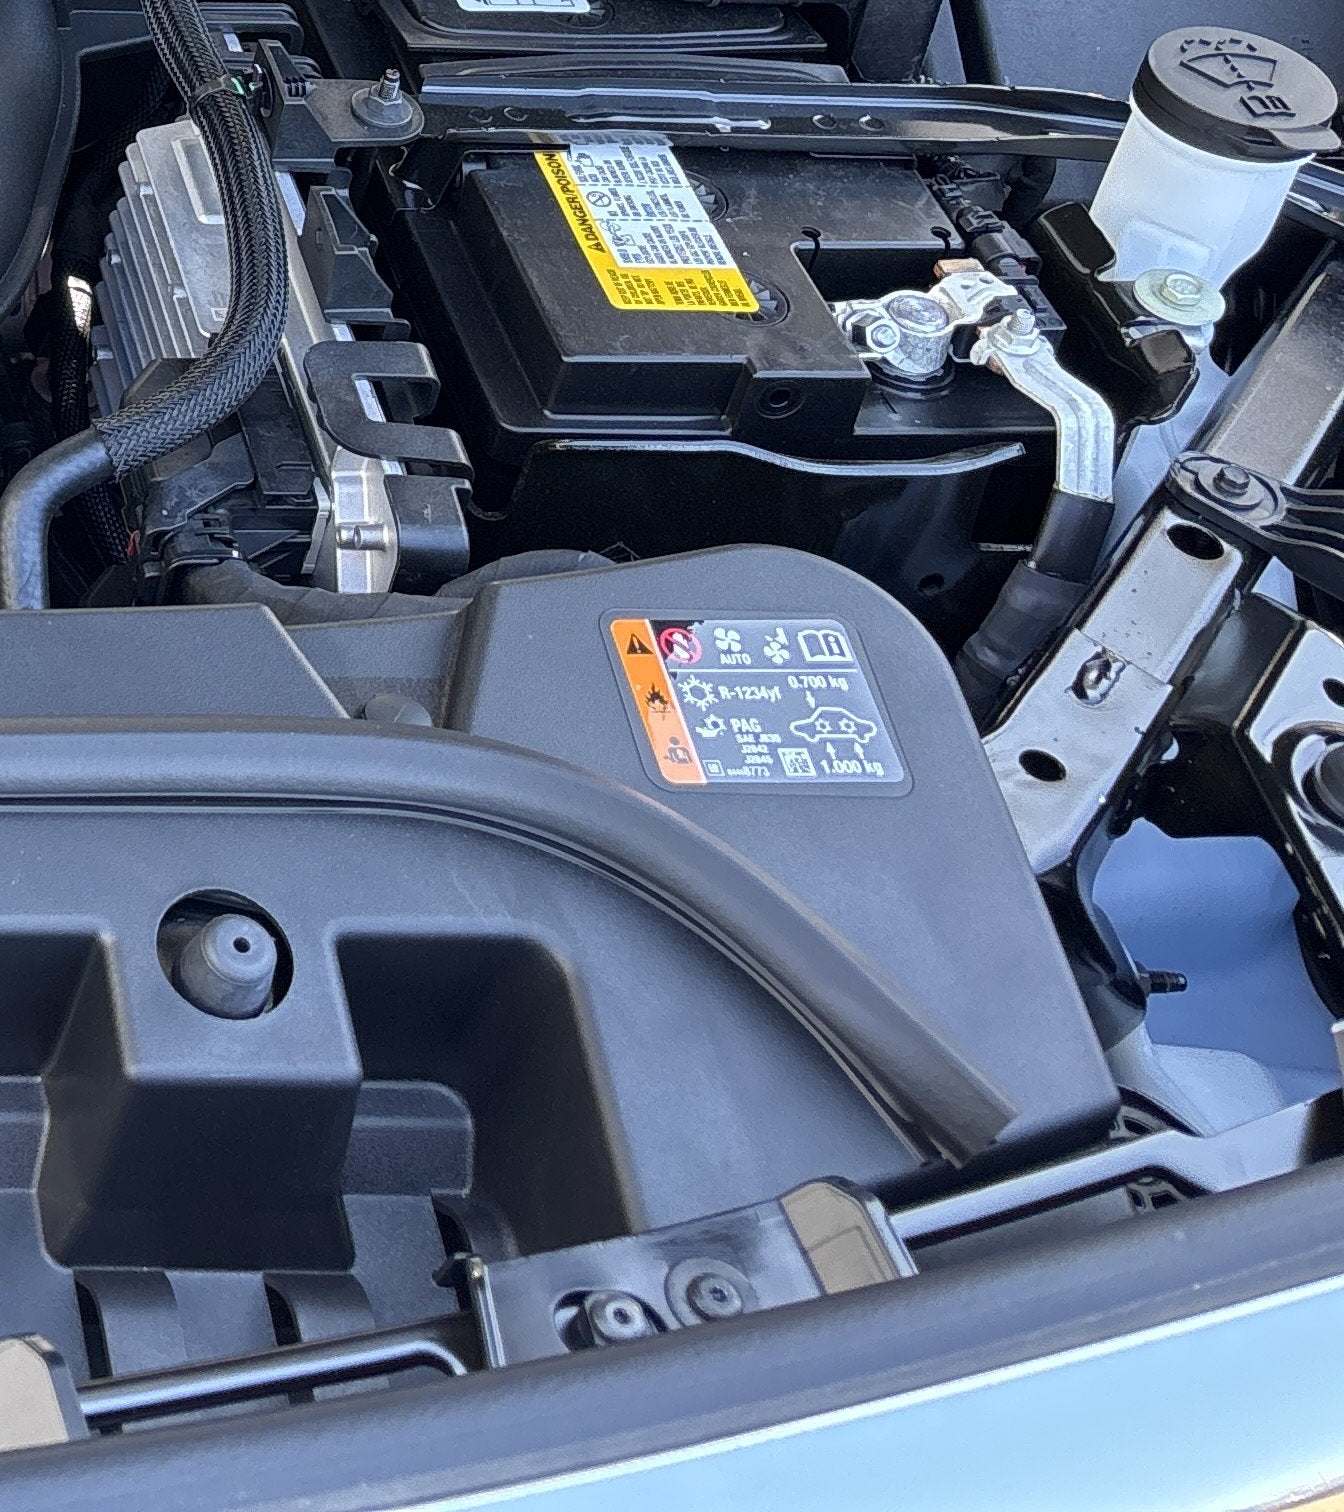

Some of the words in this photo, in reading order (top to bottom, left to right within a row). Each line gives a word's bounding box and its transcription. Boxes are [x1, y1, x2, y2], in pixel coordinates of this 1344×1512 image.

[720, 653, 752, 665] AUTO
[788, 676, 826, 689] 0.700
[829, 675, 849, 691] kg
[718, 685, 782, 703] R-1234yf
[730, 718, 762, 733] PAG
[820, 759, 861, 774] 1.000
[863, 760, 885, 776] kg
